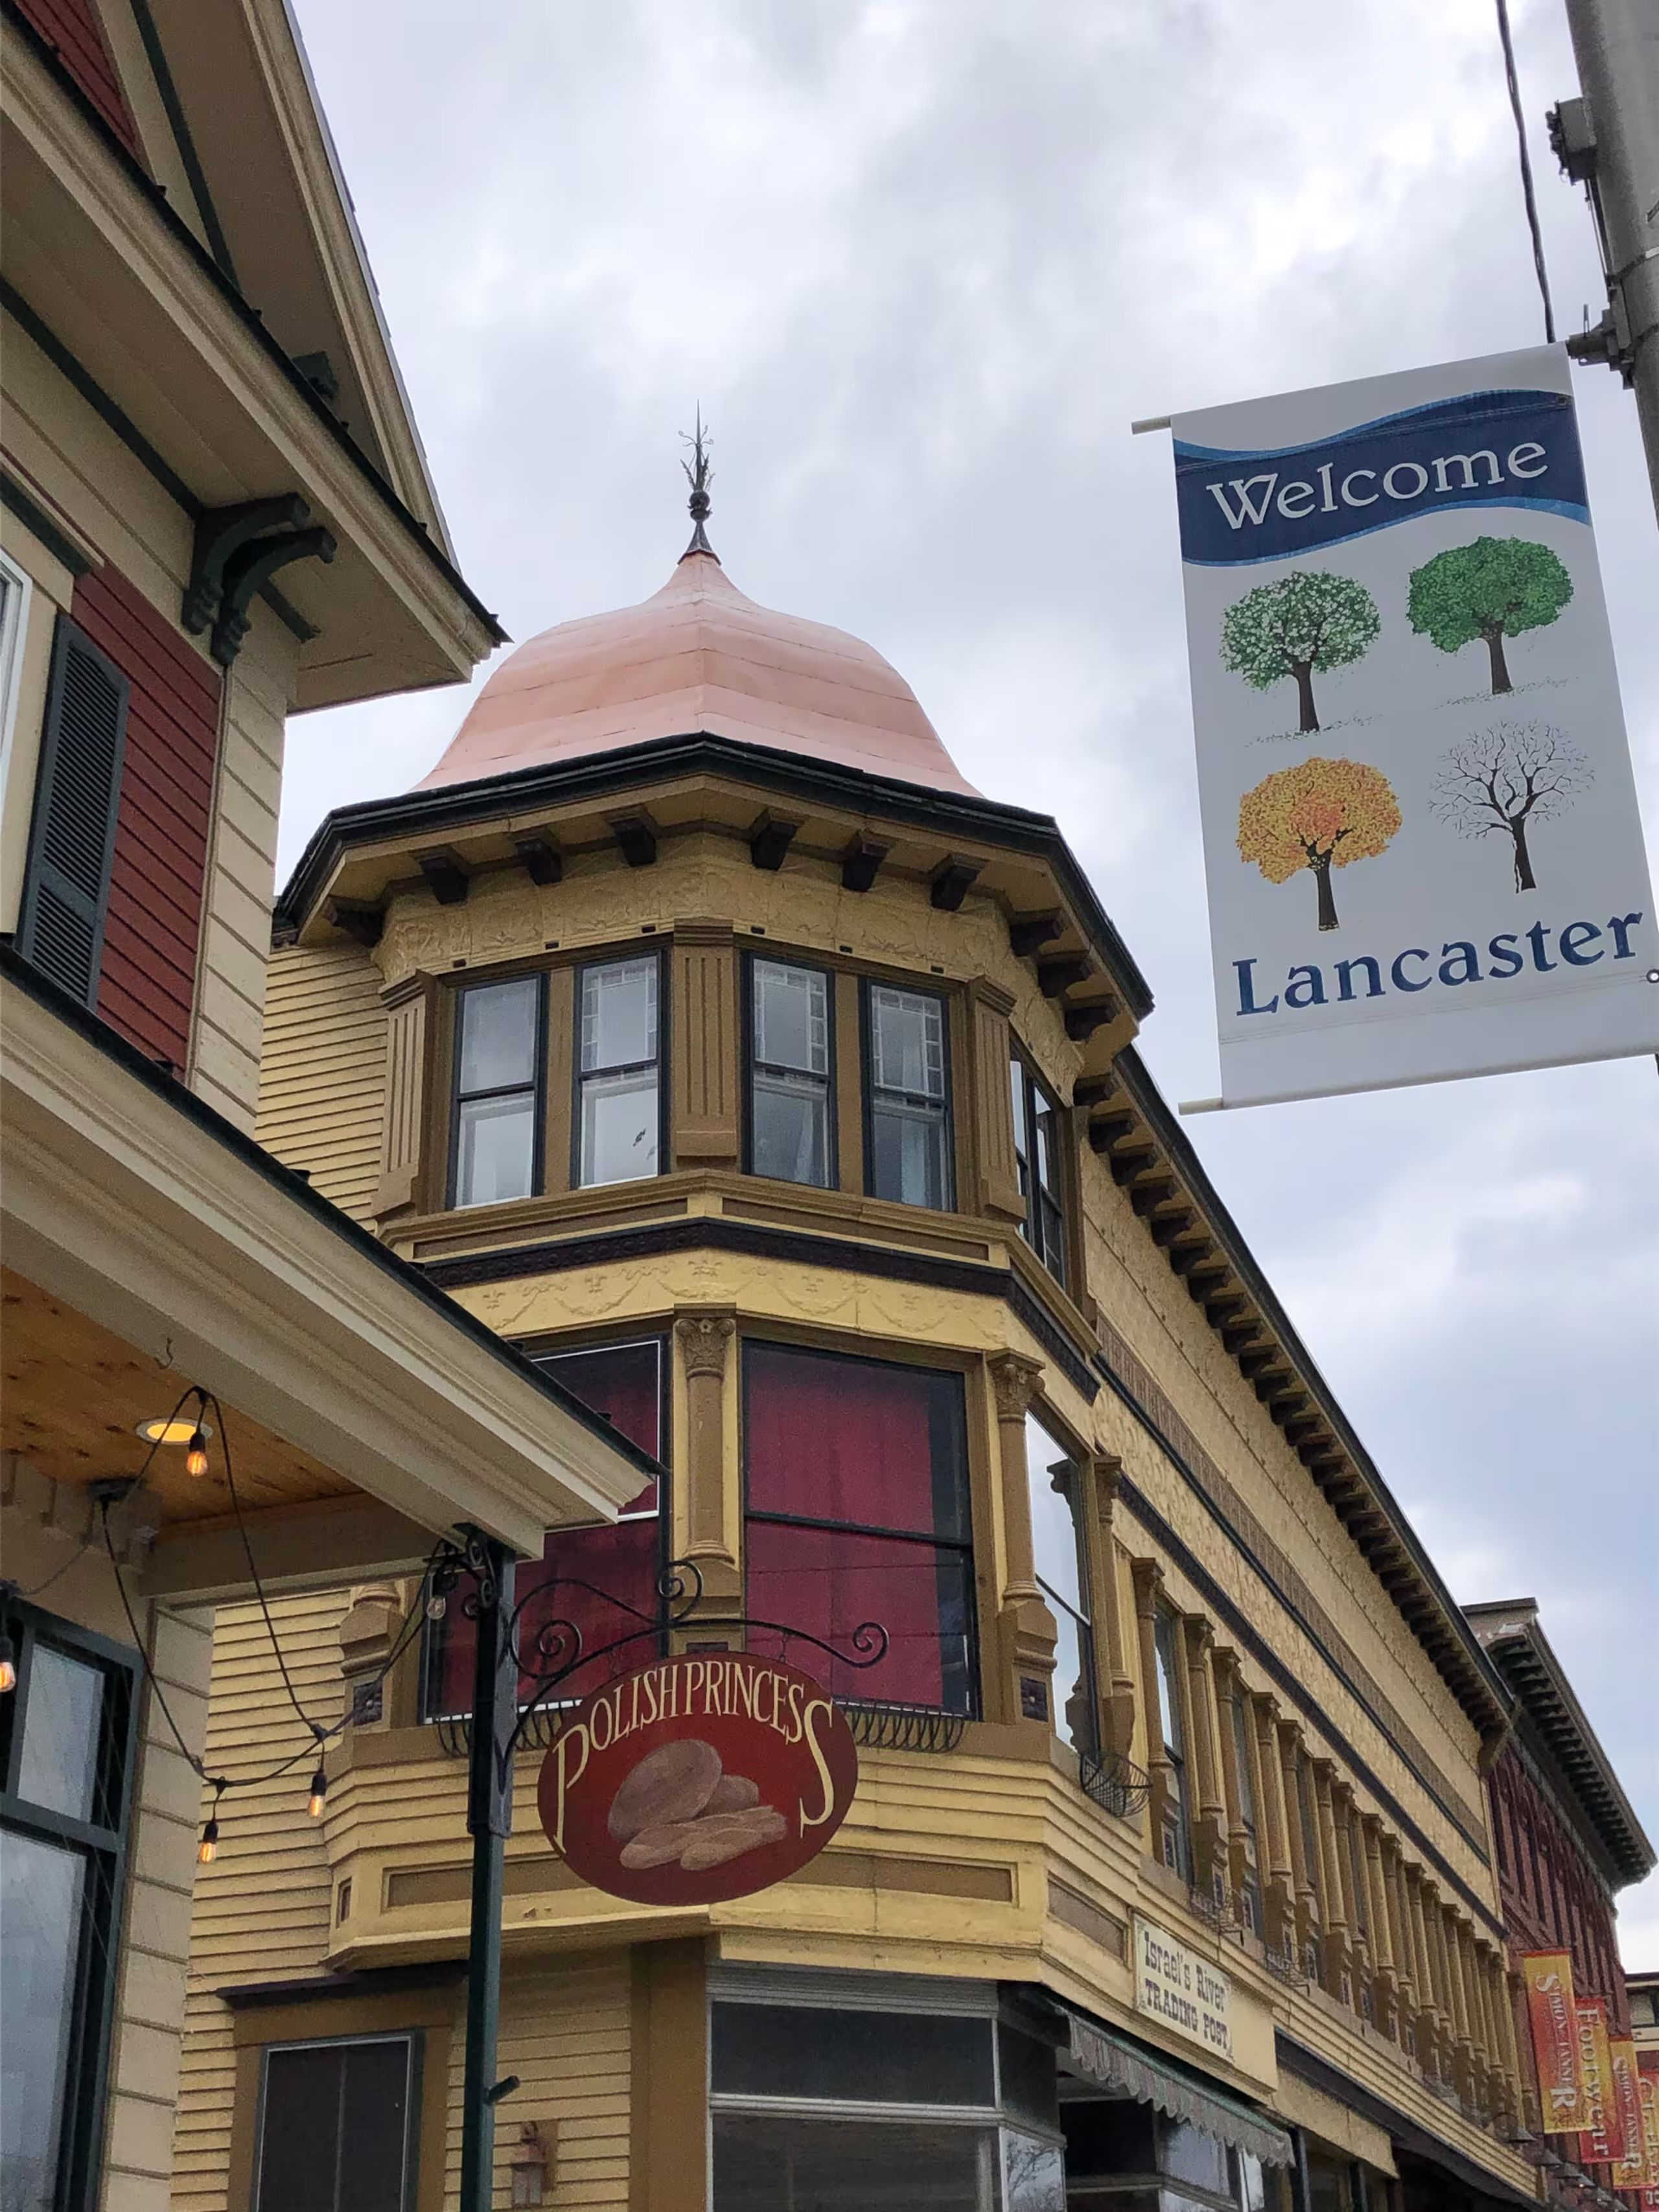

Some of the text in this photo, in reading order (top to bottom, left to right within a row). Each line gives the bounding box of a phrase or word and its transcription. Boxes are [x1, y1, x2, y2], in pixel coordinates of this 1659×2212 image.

[1206, 443, 1549, 530] Welcome
[1232, 911, 1644, 1017] Lancaster
[552, 1660, 834, 1854] POLISH PRINCESS
[1144, 1931, 1225, 2013] Israel's River
[1144, 1978, 1227, 2050] TRADING POST
